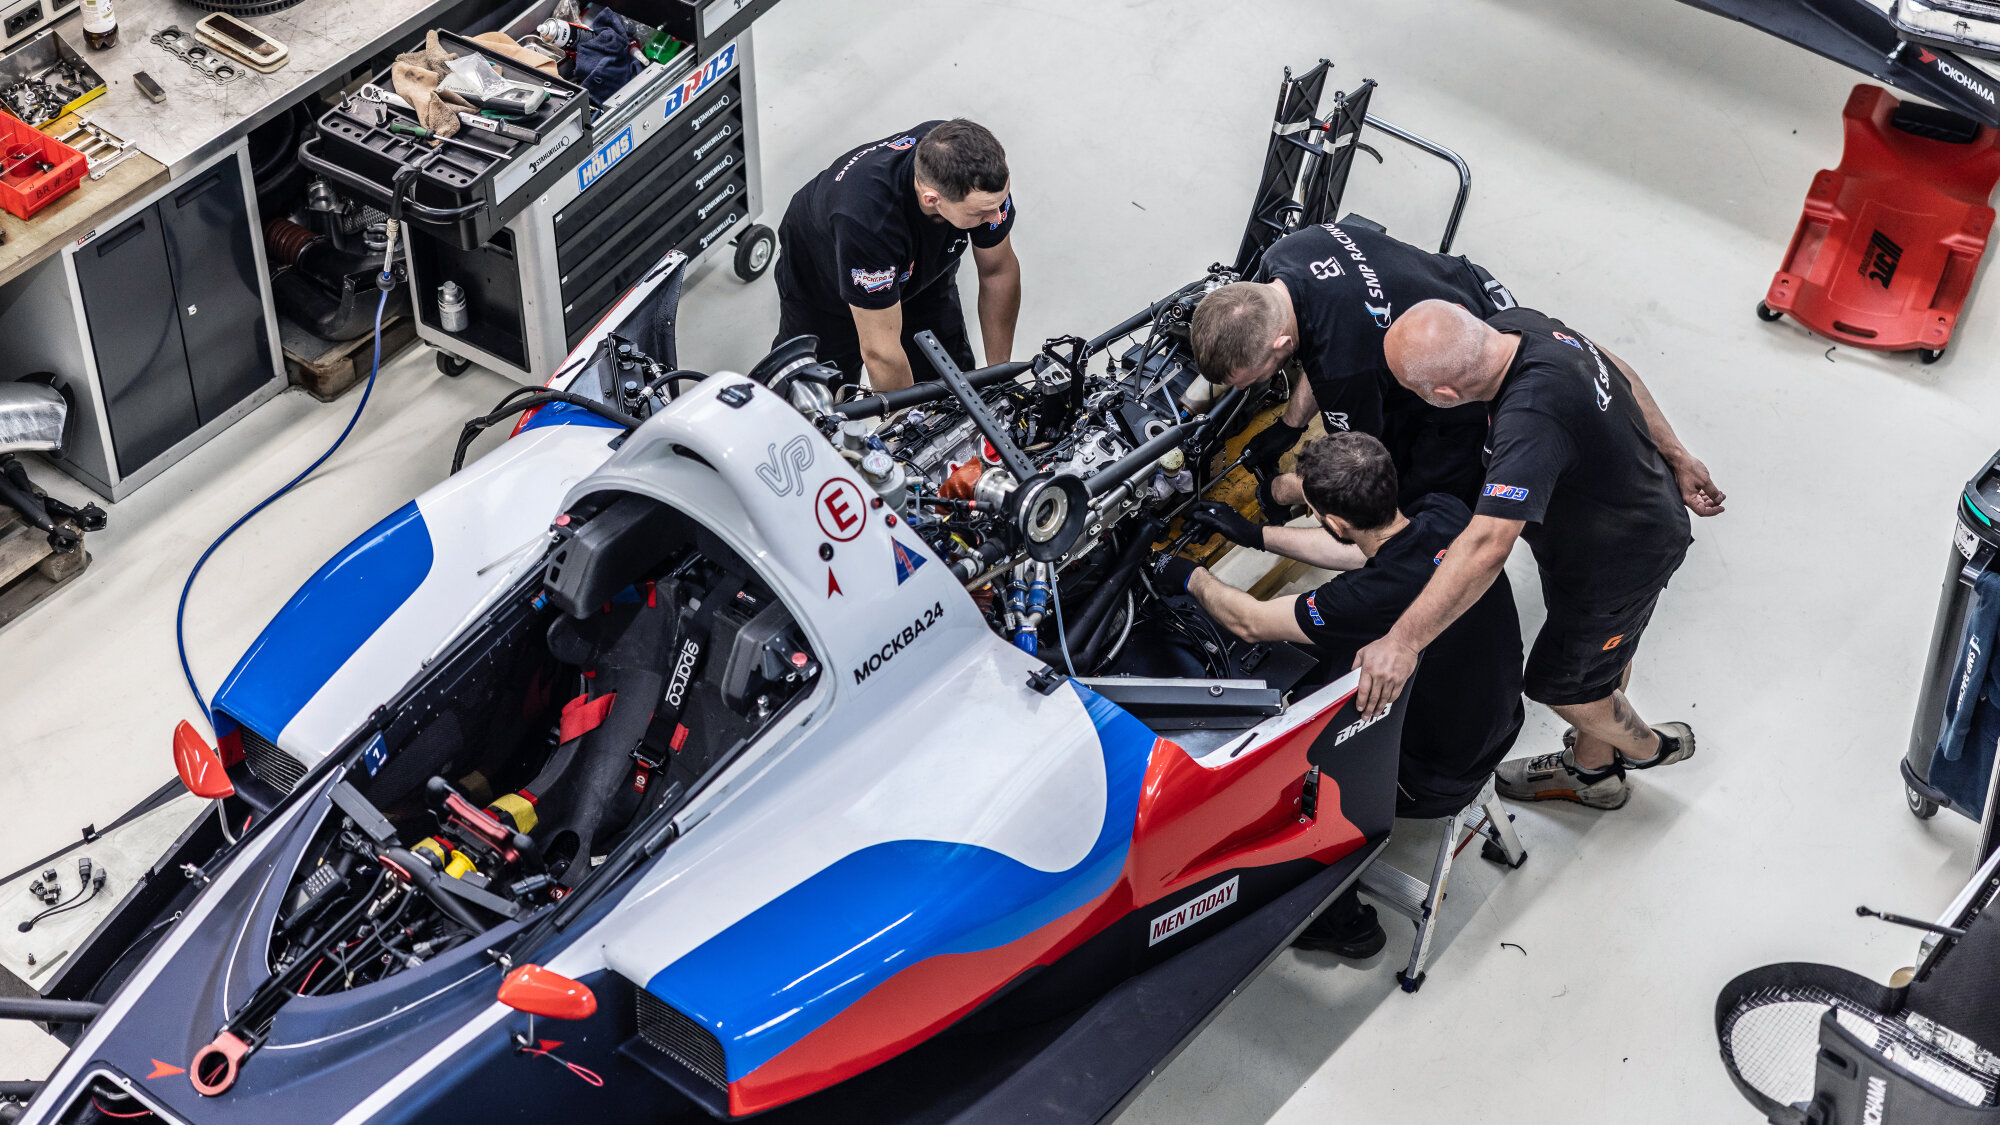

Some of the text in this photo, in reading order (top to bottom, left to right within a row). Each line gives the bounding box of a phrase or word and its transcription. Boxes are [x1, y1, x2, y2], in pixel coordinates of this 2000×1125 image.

[1937, 58, 1995, 104] YOKOHAMA
[1320, 223, 1367, 261] RACING
[1358, 264, 1384, 299] SMP
[823, 486, 859, 533] E
[665, 640, 700, 708] sparco
[1153, 882, 1235, 940] MEN TODAY
